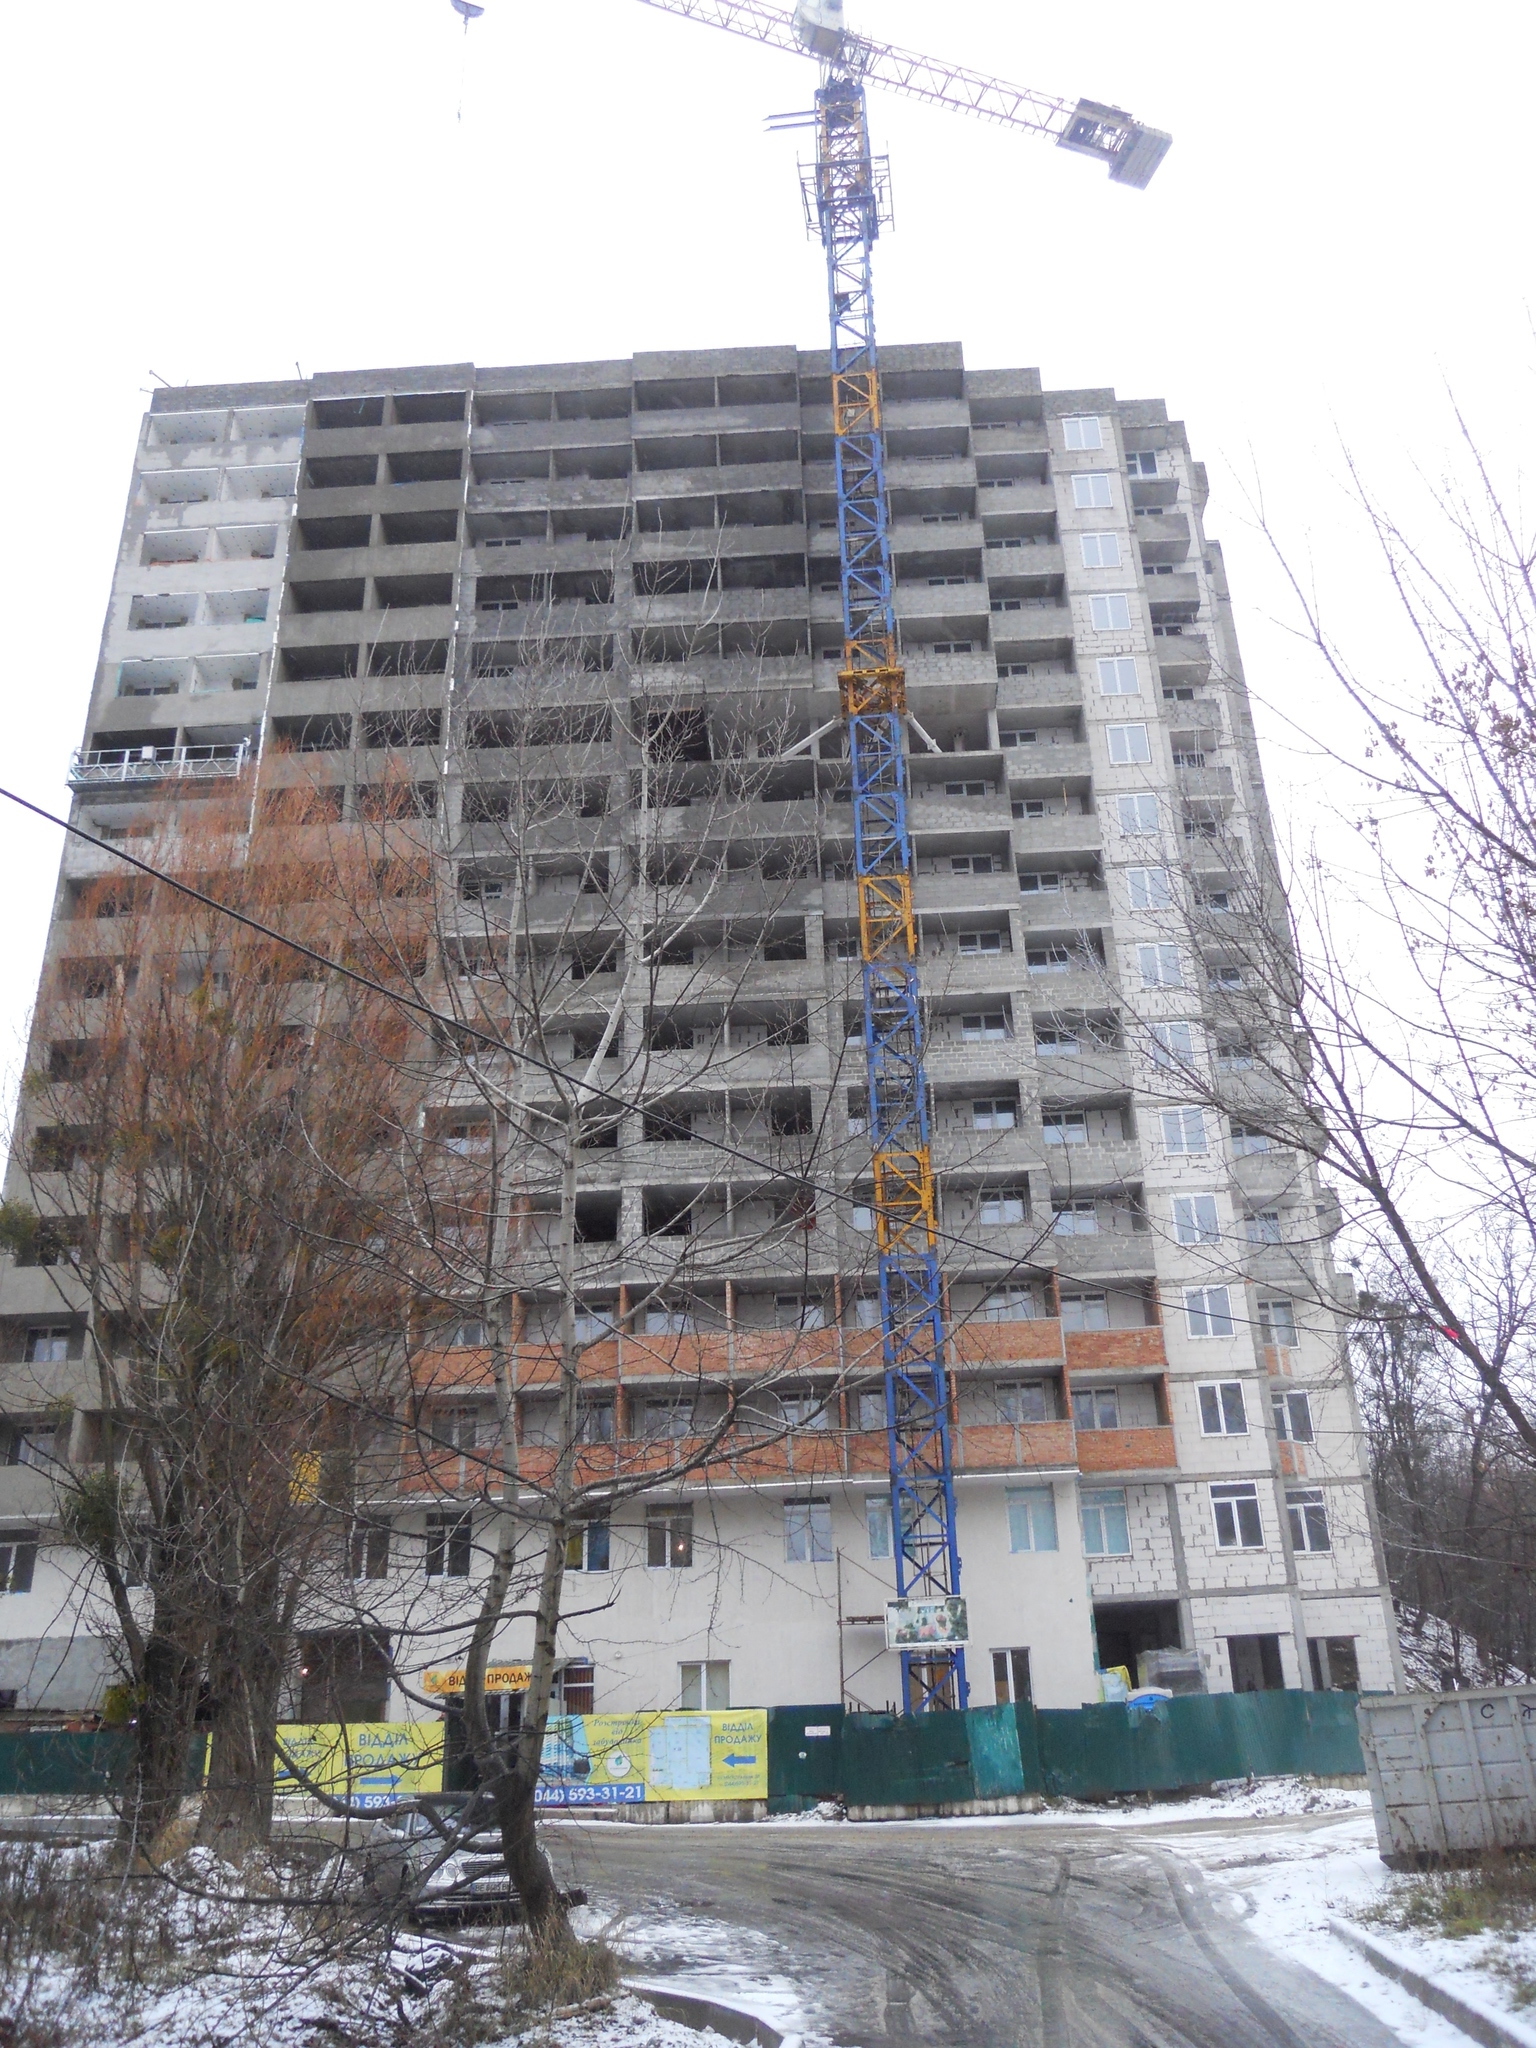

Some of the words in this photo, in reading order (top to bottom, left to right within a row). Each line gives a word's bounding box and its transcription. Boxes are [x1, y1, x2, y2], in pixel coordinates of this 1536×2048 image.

[487, 1672, 532, 1684] ПРОДАЖ
[722, 1723, 753, 1733] ВІДДІЛ
[359, 1734, 408, 1748] ВІДДІЛ
[714, 1735, 762, 1745] ПРОДАЖУ
[535, 1789, 565, 1802] 044)
[568, 1785, 642, 1800] 593-31-21
